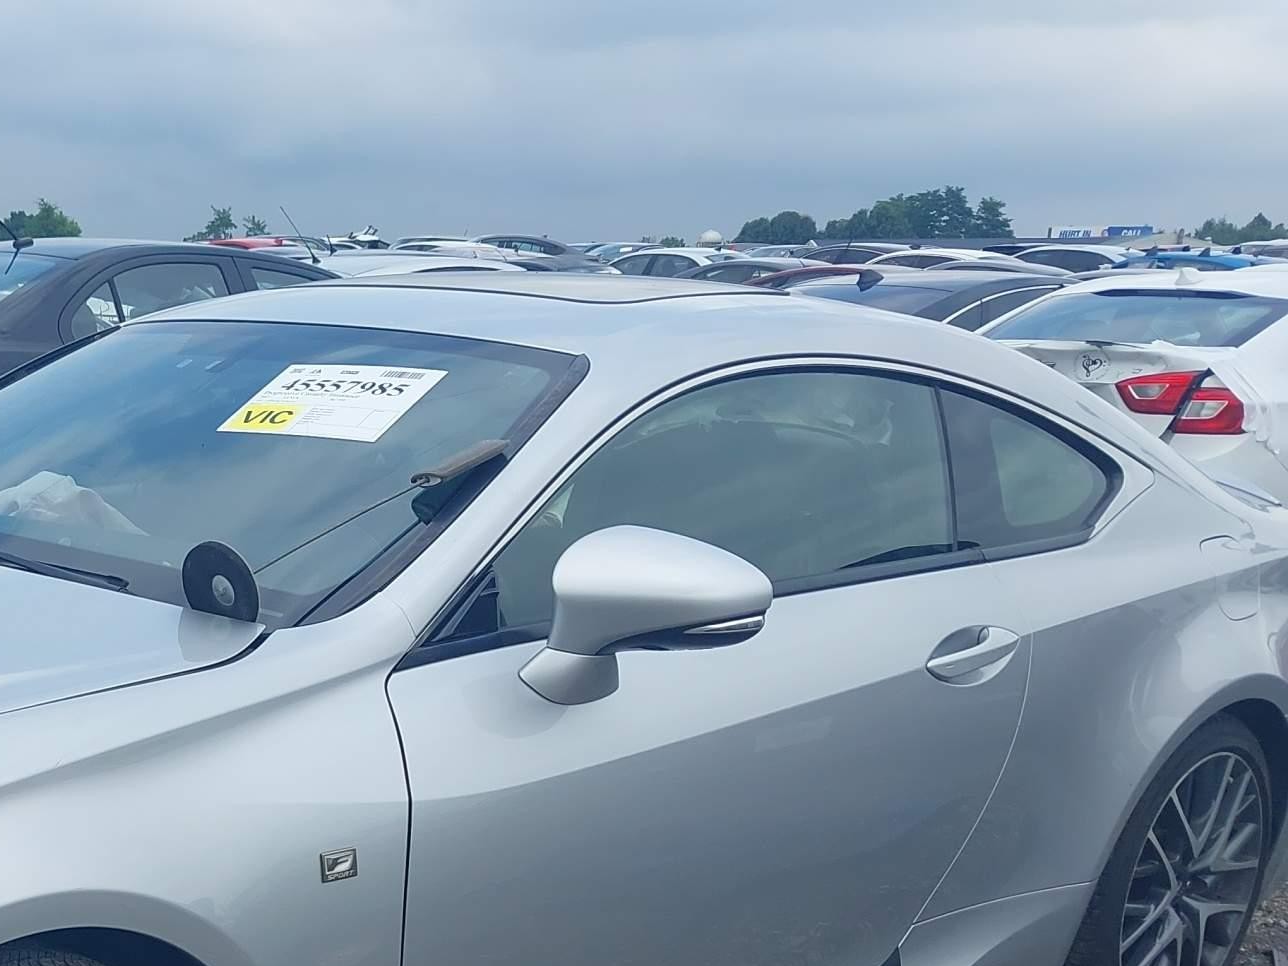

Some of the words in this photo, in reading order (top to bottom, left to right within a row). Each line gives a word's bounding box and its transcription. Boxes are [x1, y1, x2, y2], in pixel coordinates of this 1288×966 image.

[1058, 229, 1081, 238] HURT
[281, 379, 412, 397] 45557985
[243, 410, 295, 425] VIC
